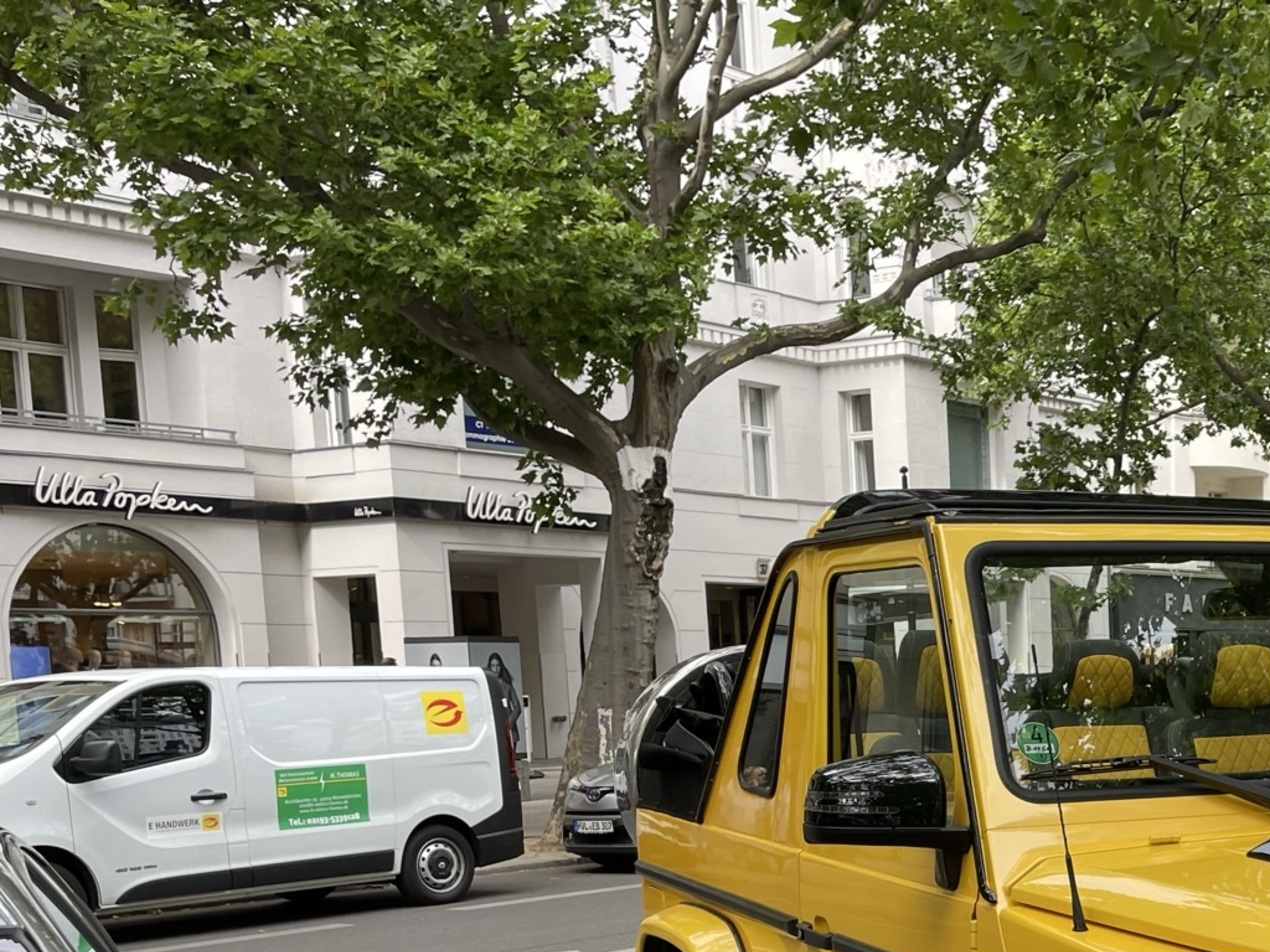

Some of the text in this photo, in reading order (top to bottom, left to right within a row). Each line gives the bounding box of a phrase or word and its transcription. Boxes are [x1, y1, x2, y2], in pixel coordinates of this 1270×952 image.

[35, 466, 213, 520] Ulla Popken
[466, 486, 513, 521] Ulla
[1031, 725, 1043, 743] 4
[148, 818, 200, 831] E HANDWERK
